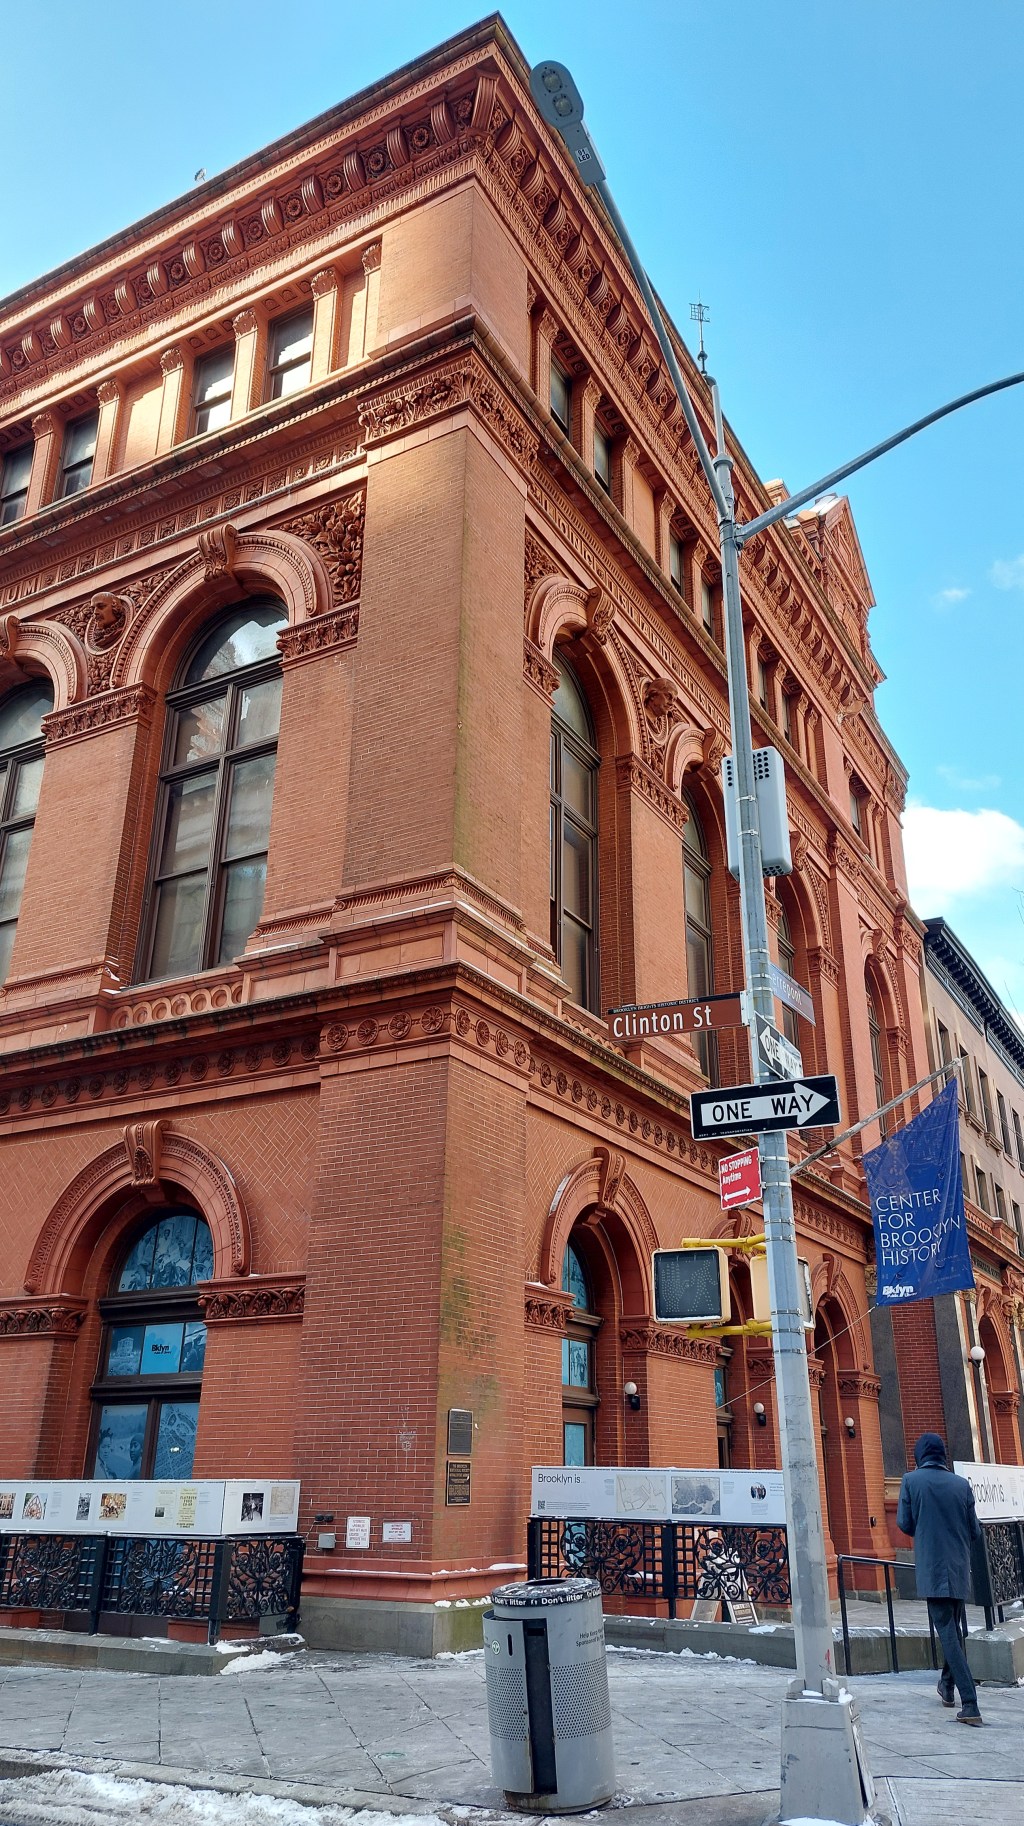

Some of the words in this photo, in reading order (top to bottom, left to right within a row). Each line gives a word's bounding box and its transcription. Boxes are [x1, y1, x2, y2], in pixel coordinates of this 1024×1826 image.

[578, 153, 590, 162] LED
[6, 577, 41, 603] UM
[606, 577, 670, 662] ISLAND
[771, 972, 803, 1006] errepont
[613, 1012, 684, 1038] Clinton
[693, 1005, 712, 1028] St
[764, 1034, 780, 1060] ONE
[784, 1054, 798, 1073] WAY
[712, 1101, 752, 1122] ONE
[771, 1093, 814, 1115] WAY
[721, 1163, 728, 1174] NO
[728, 1155, 752, 1171] STOPPING
[722, 1172, 742, 1185] Anytime
[876, 1188, 942, 1212] CENTER
[878, 1212, 915, 1230] FOR
[882, 1237, 943, 1266] HISTORY
[882, 1284, 914, 1297] Bklyn
[538, 1473, 573, 1485] Brooklyn
[494, 1596, 507, 1605] Don't
[509, 1598, 526, 1606] litter
[541, 1596, 564, 1605] Don't
[566, 1593, 584, 1602] litter
